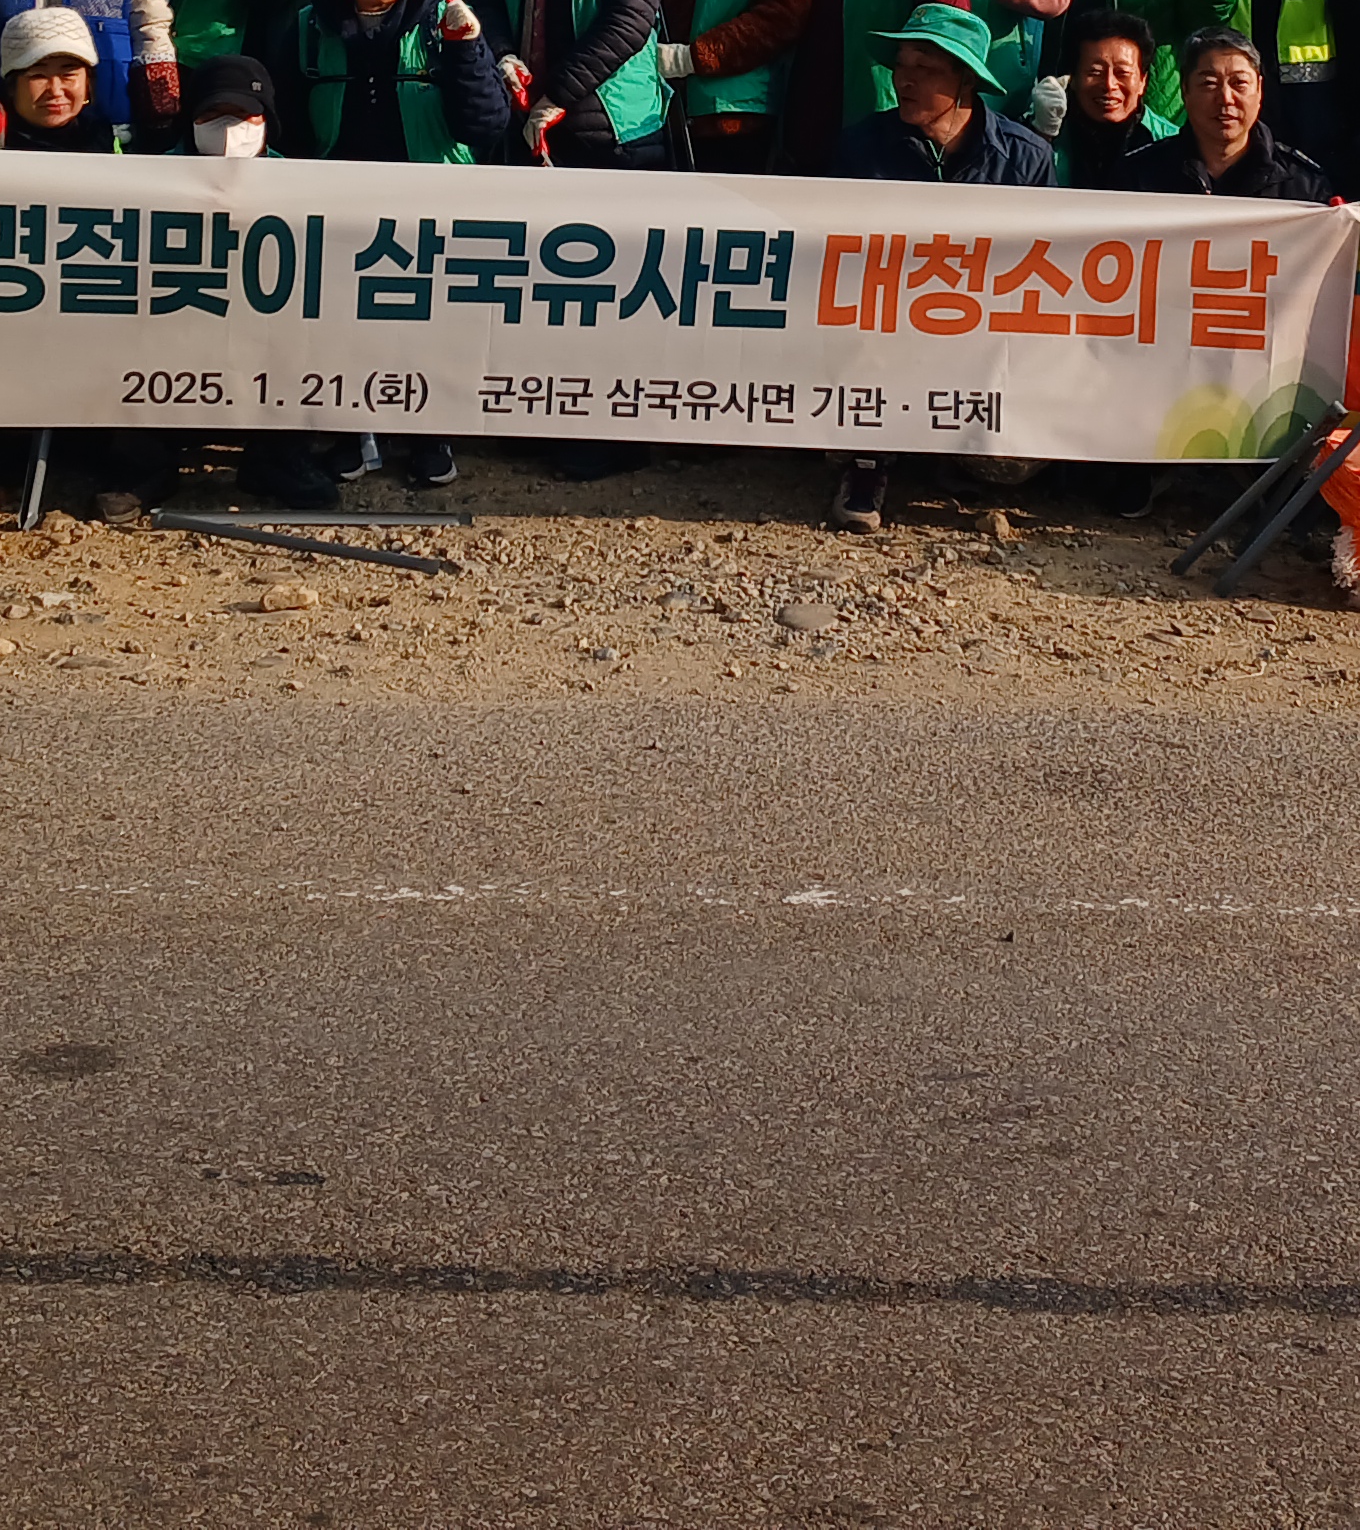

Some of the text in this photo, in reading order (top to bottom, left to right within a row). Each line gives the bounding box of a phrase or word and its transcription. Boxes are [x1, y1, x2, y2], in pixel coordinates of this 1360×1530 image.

[354, 217, 796, 330] 삼국유사면
[817, 233, 1163, 345] 대청소의
[1191, 239, 1280, 351] 날
[121, 371, 233, 406] 2025.
[253, 373, 284, 407] 1.
[300, 372, 429, 414] 21.(화)
[478, 375, 594, 416] 군위군
[606, 378, 795, 424] 삼국유사면
[811, 385, 887, 428] 기관
[928, 389, 1002, 433] 단체
